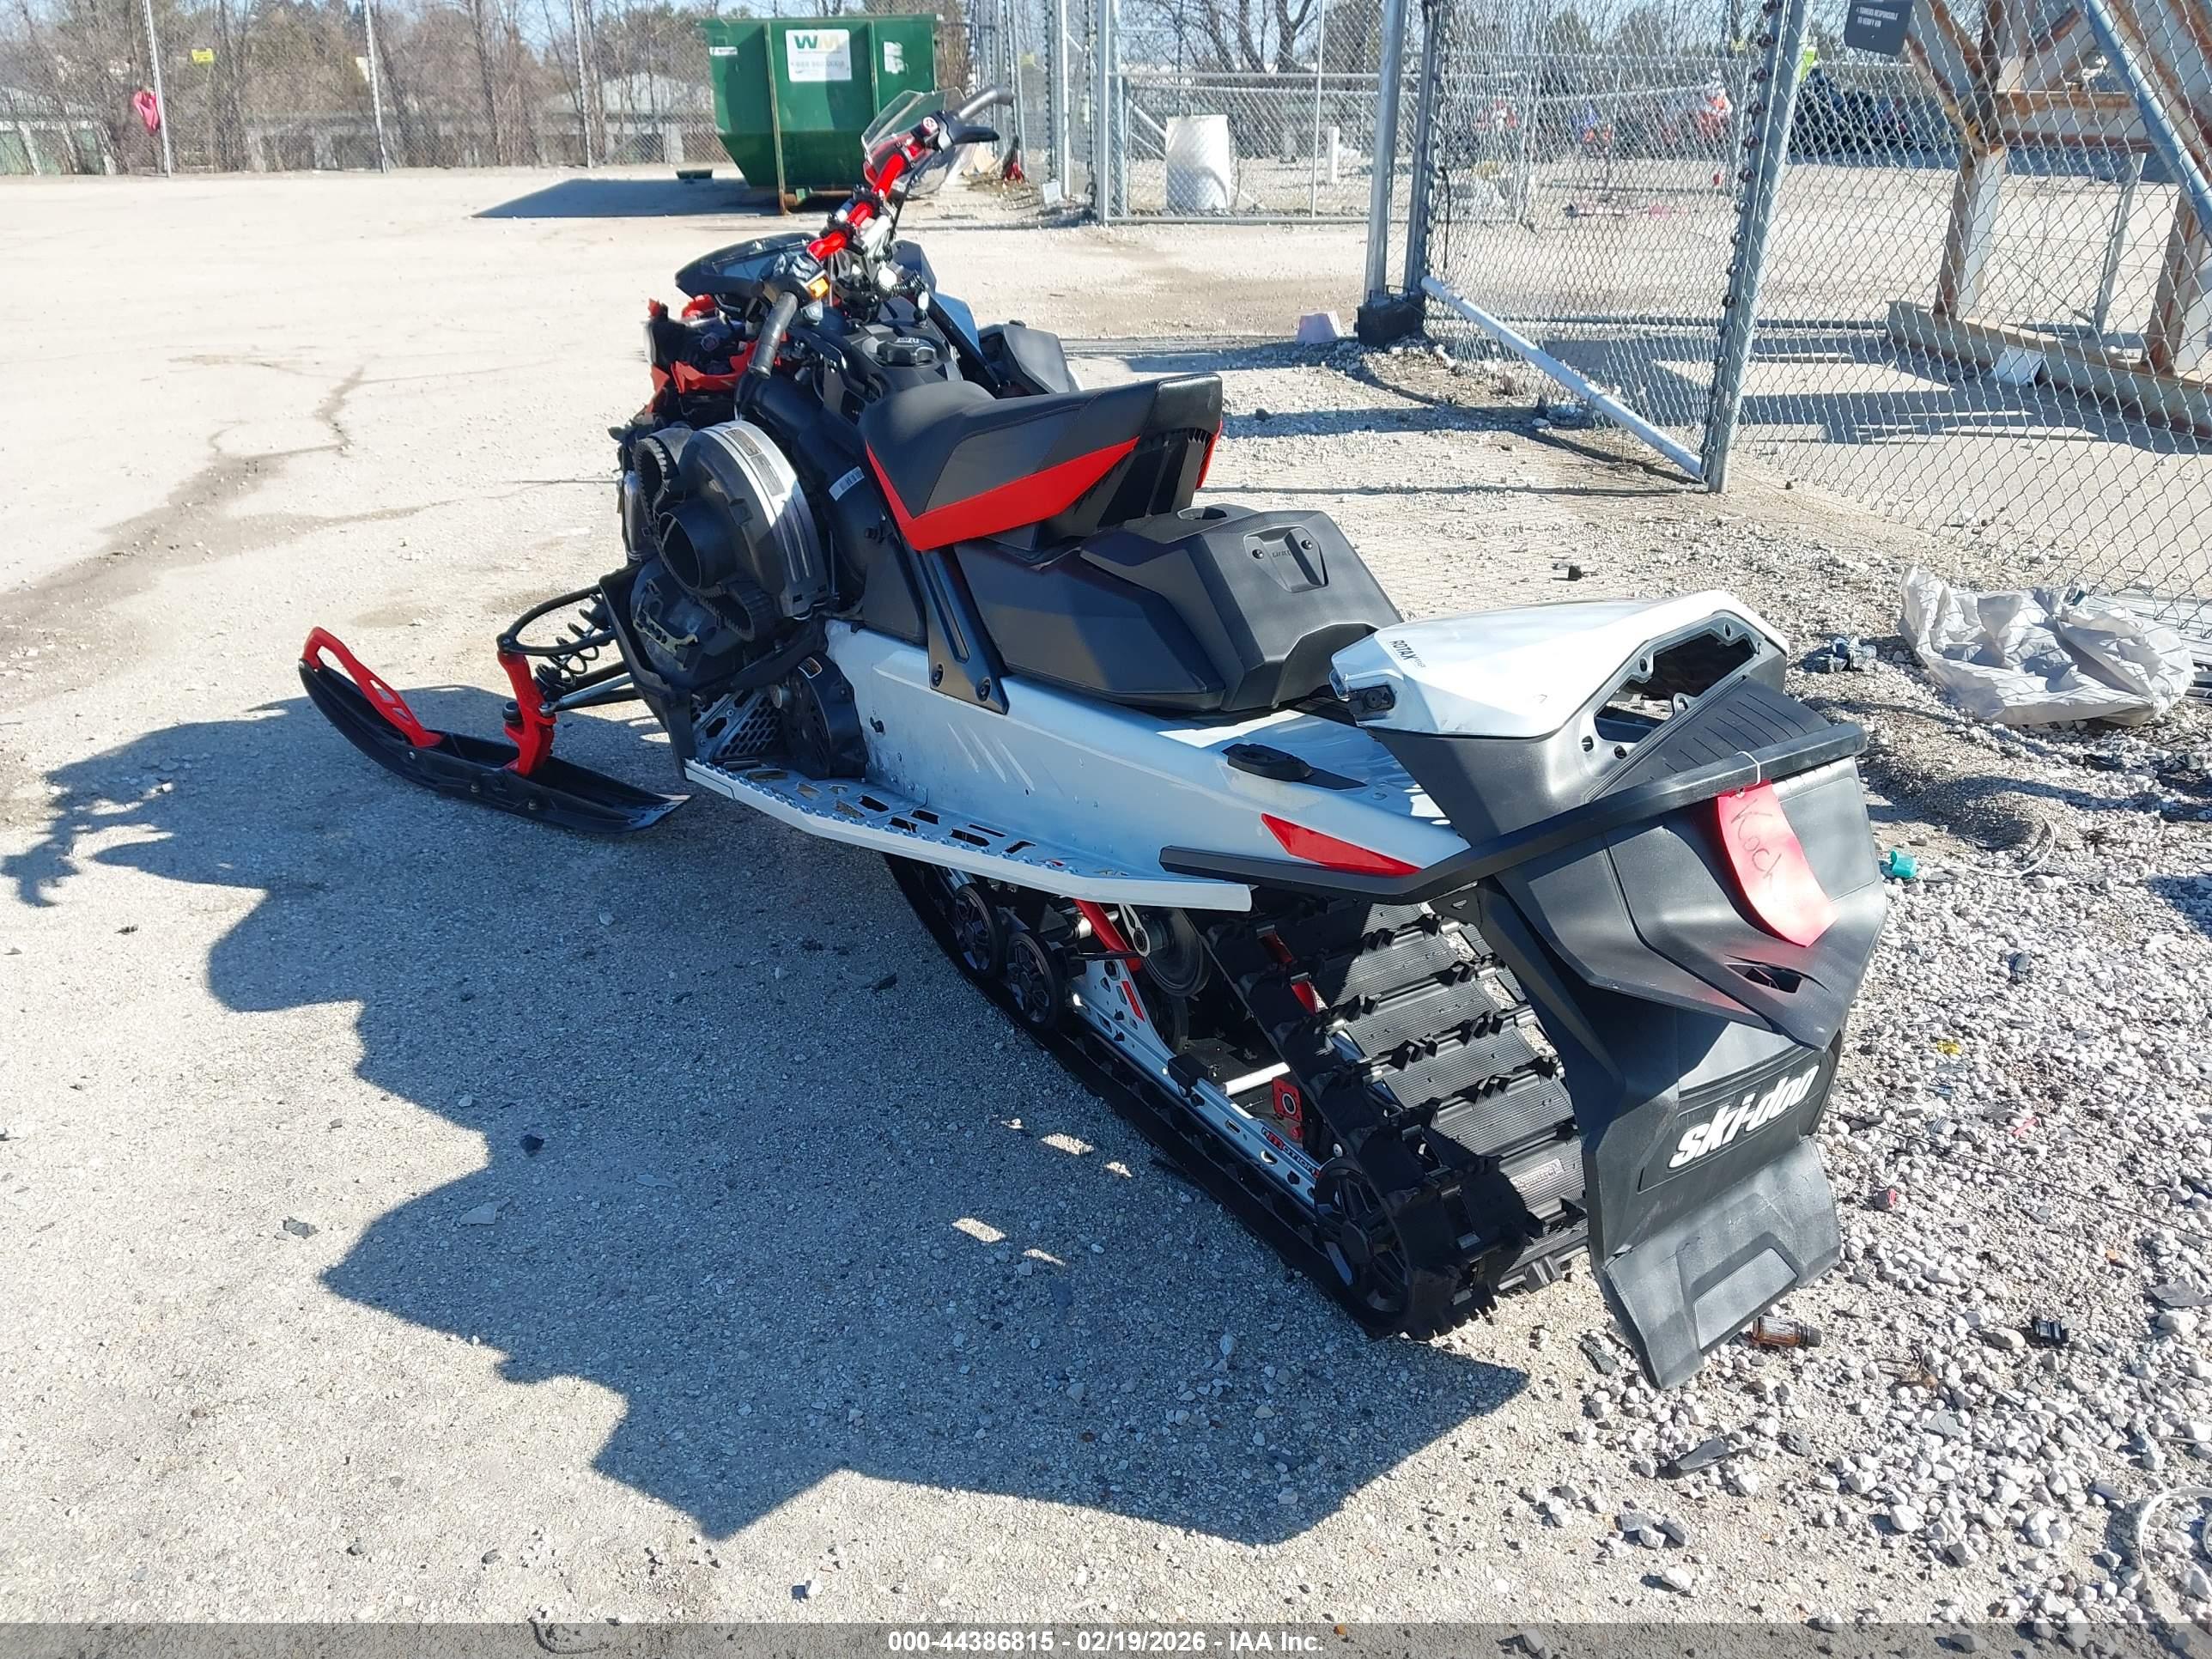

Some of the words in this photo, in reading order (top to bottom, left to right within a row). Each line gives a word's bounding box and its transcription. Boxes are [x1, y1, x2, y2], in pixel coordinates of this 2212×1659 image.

[793, 34, 841, 49] WM
[1389, 639, 1419, 660] ROTAX
[1668, 1065, 1820, 1168] ski-doo
